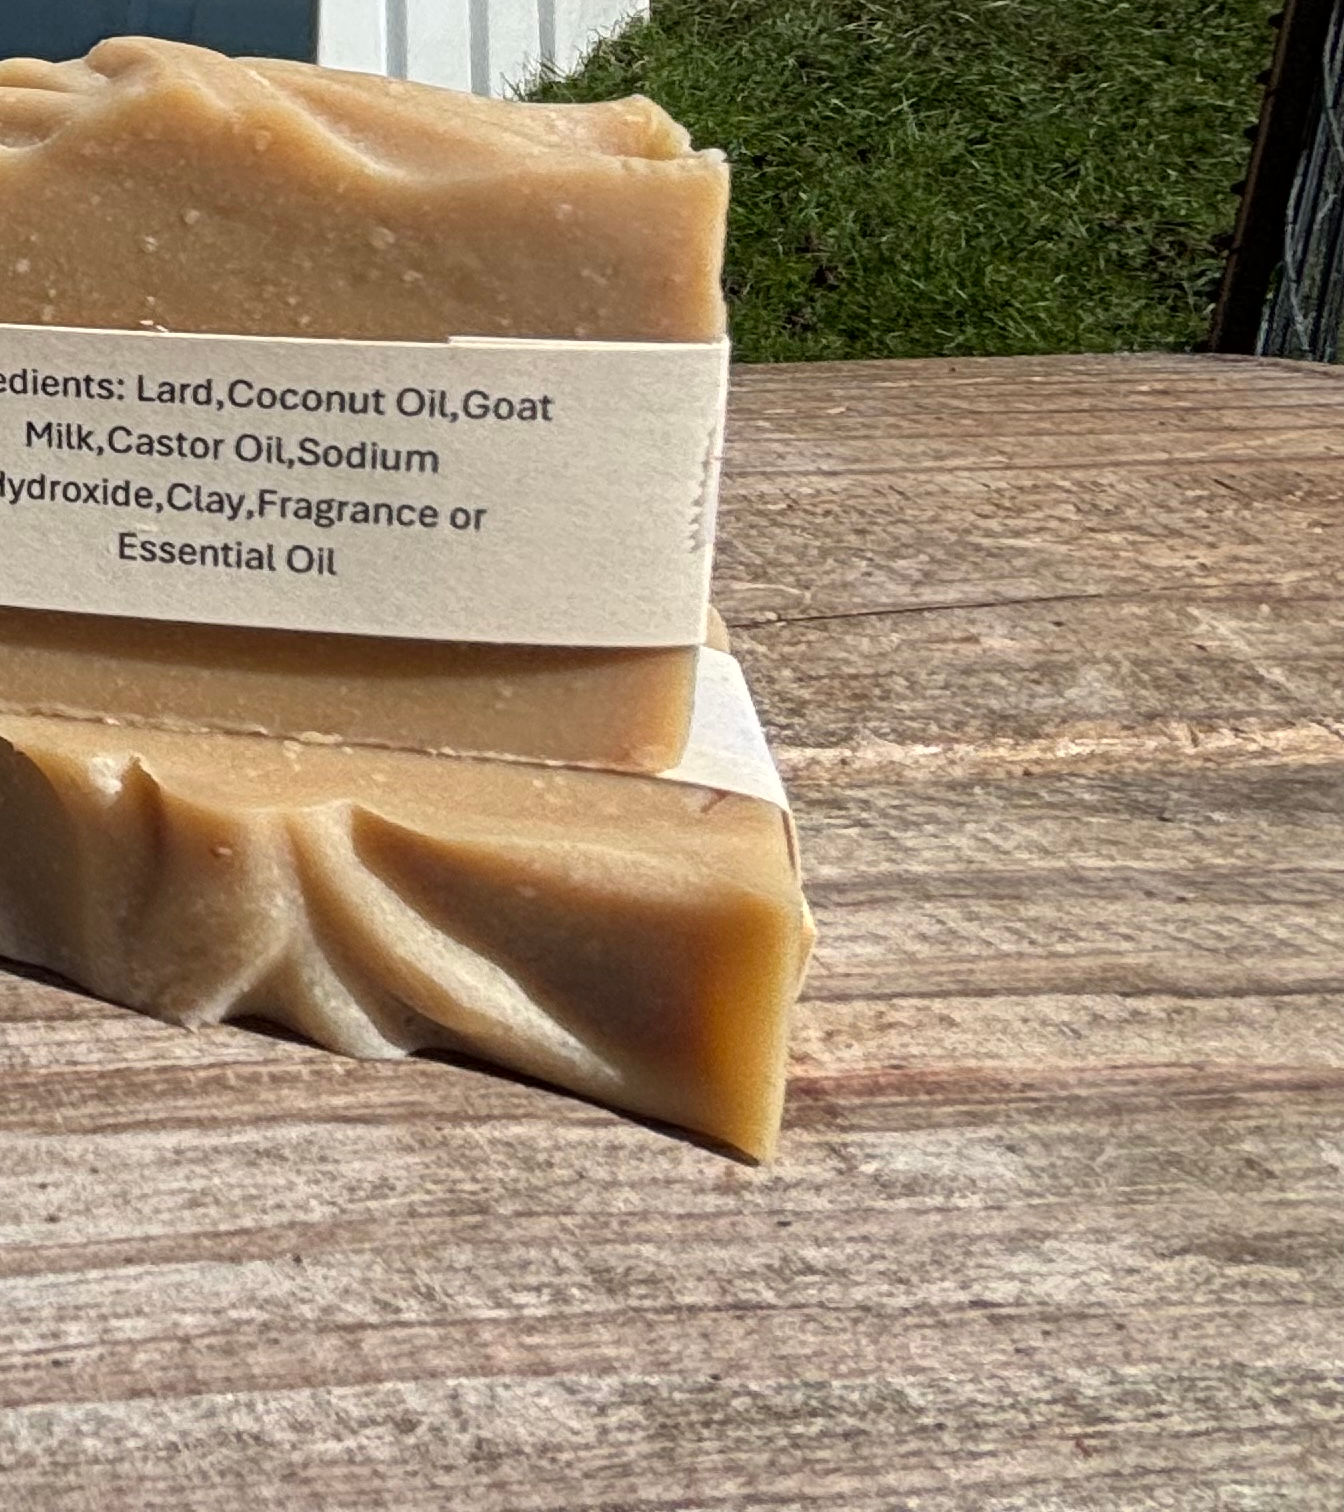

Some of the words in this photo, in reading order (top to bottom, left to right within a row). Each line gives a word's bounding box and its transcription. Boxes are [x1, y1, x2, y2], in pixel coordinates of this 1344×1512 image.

[136, 373, 387, 417] Lard,Coconut
[394, 386, 556, 425] Oil,Goat
[24, 419, 227, 463] Milk,Castor
[233, 432, 441, 475] Oil,Sodium
[448, 505, 489, 533] or
[117, 530, 278, 573] Essential
[286, 543, 339, 578] Oil
